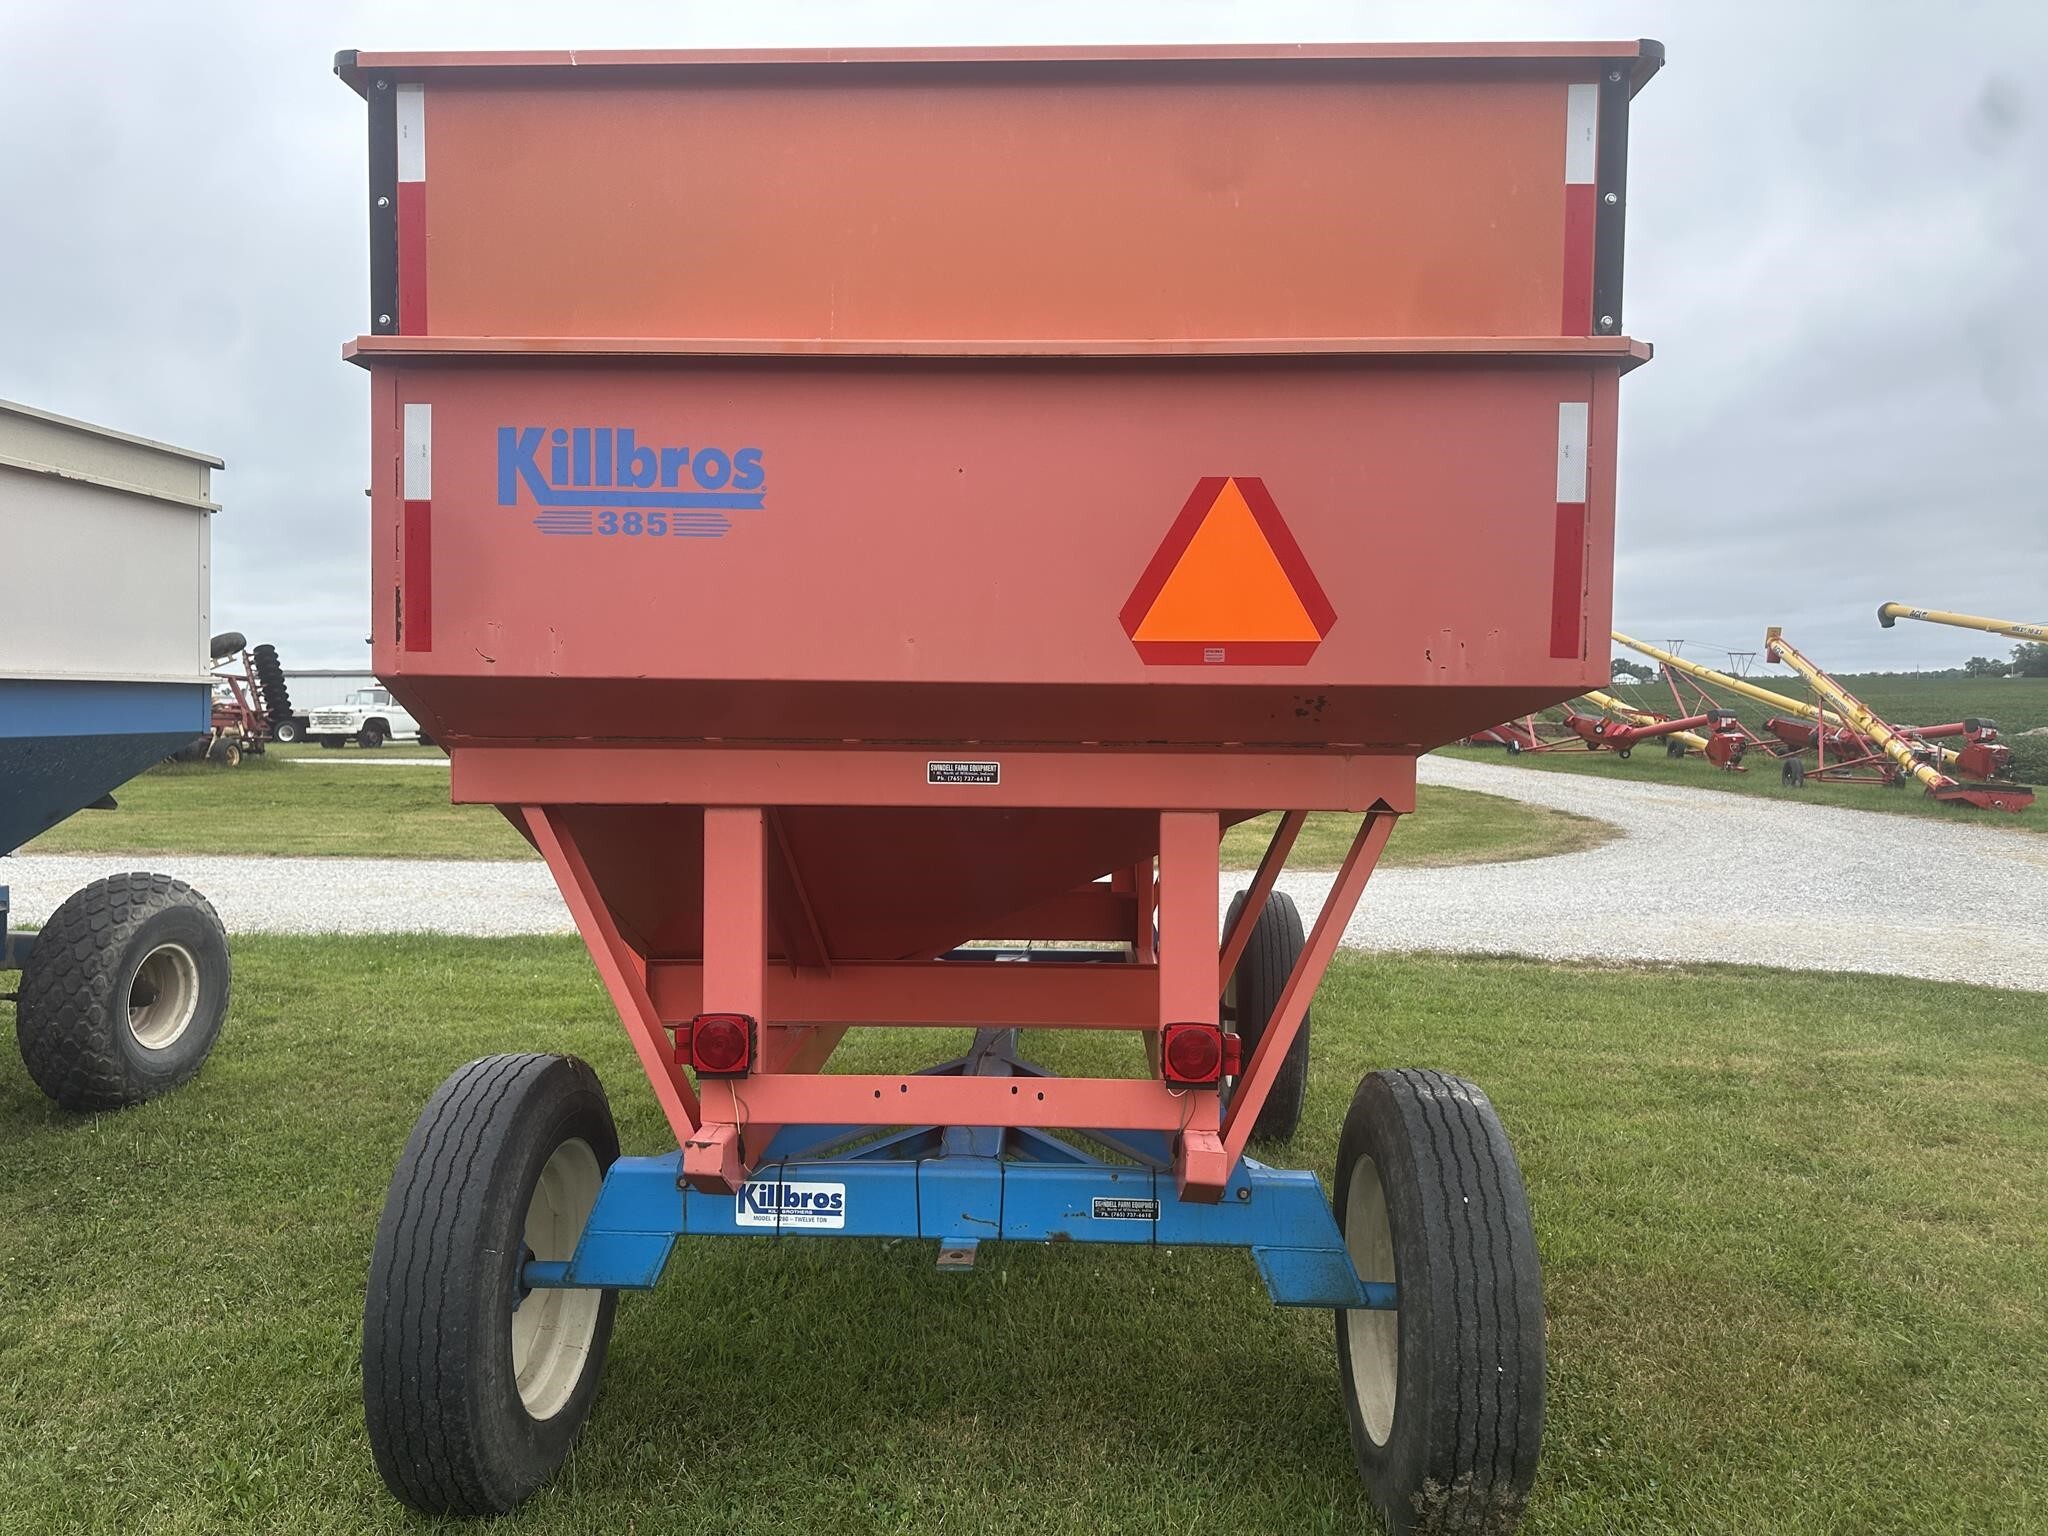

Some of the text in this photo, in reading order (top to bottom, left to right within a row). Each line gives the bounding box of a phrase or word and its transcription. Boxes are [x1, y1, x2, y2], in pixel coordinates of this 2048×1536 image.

[498, 427, 765, 506] Killbros
[597, 511, 668, 536] 385
[738, 1184, 842, 1214] Killbros
